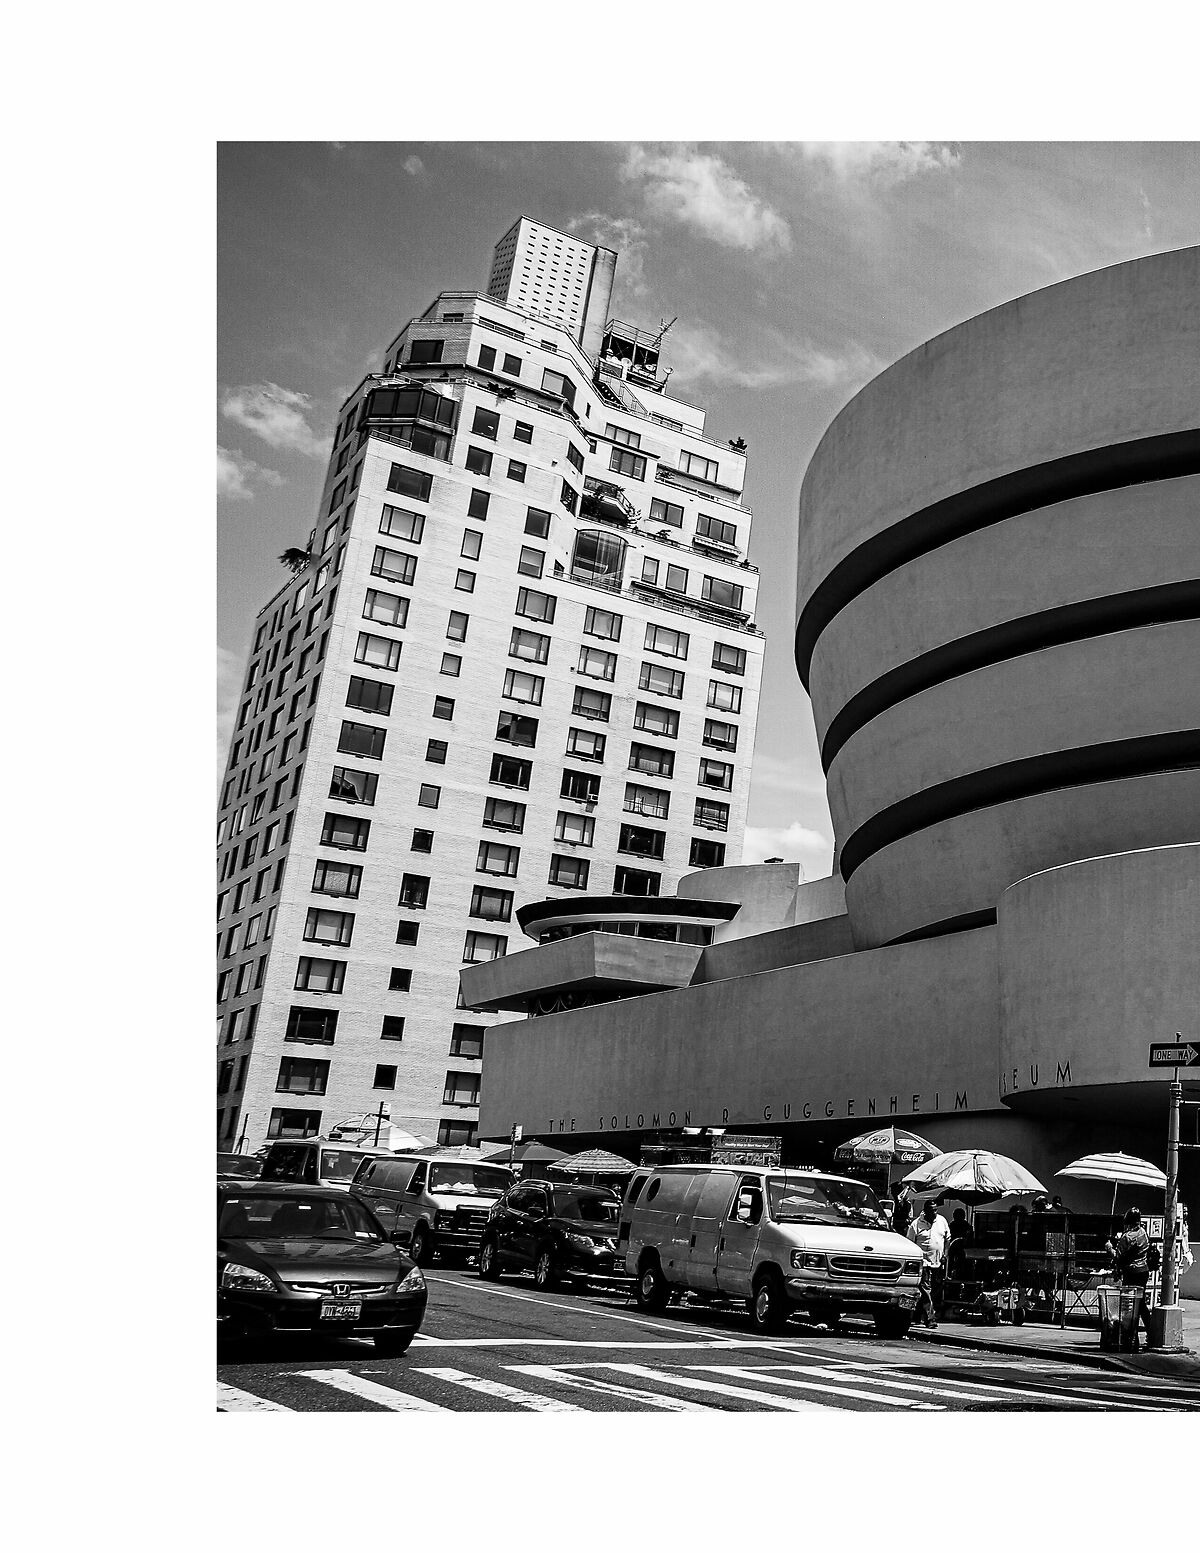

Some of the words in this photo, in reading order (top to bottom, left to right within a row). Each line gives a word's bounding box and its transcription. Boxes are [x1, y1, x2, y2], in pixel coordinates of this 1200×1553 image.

[1156, 1050, 1172, 1060] ONE
[1178, 1049, 1194, 1060] WAY
[549, 1118, 576, 1133] THE
[599, 1110, 692, 1130] SOLOMON
[722, 1108, 730, 1124] R
[763, 1090, 969, 1121] GUGGENHEIM
